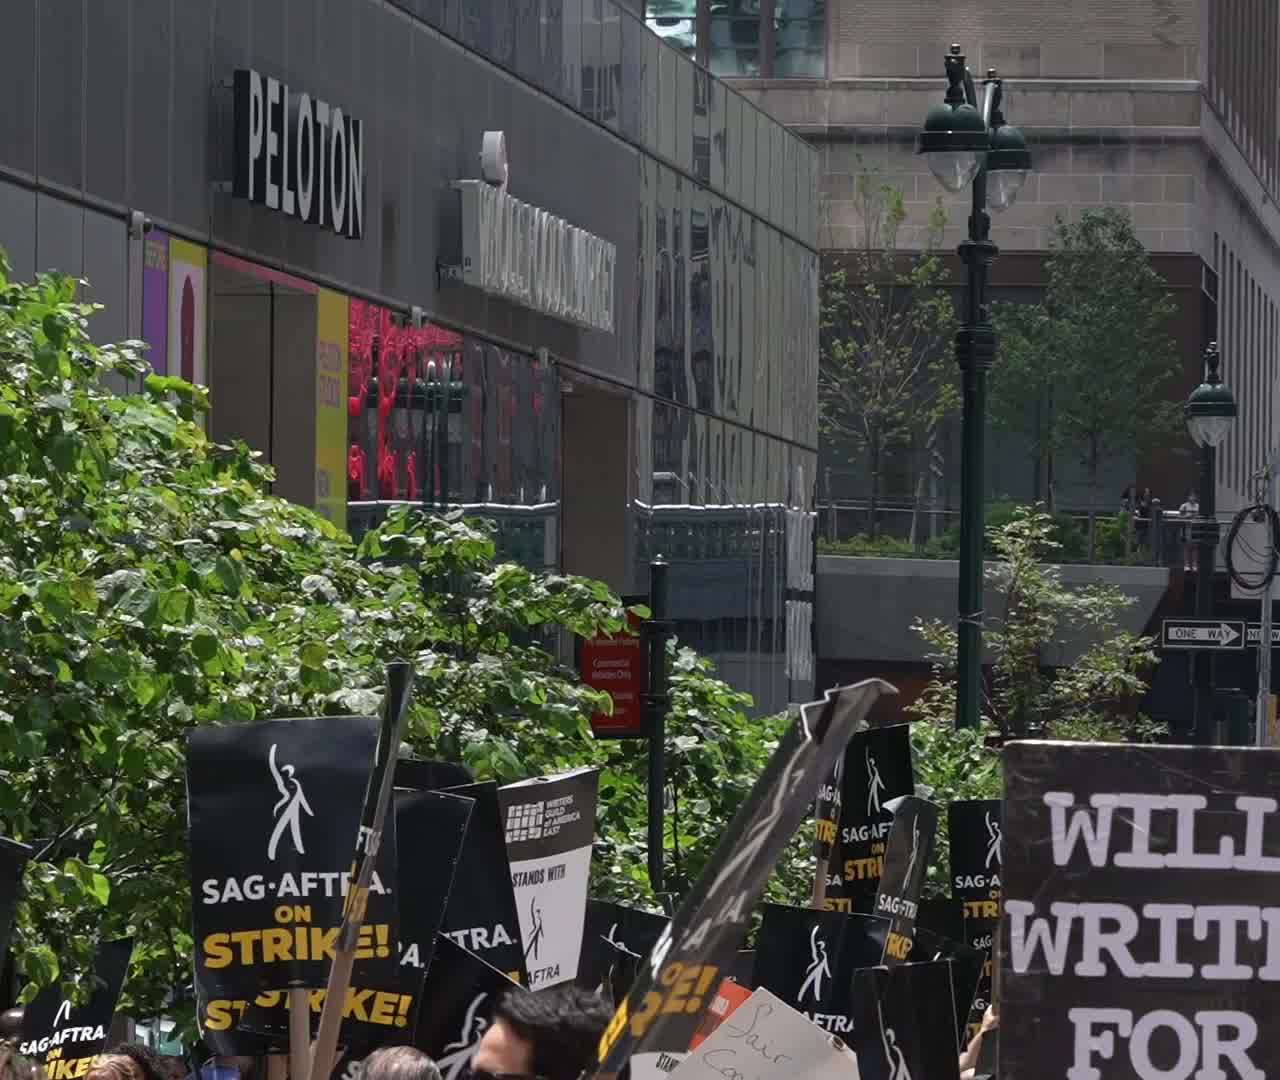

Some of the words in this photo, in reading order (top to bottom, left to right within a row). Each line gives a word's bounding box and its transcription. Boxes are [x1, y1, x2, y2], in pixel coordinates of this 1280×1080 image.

[248, 69, 363, 240] PELOTON
[1176, 629, 1197, 639] ONE
[1208, 629, 1231, 639] WAY
[512, 867, 545, 888] STANDS
[548, 863, 566, 881] WITH
[274, 905, 311, 923] ON
[203, 925, 389, 969] STRIKE!
[526, 964, 561, 984] AFTRA
